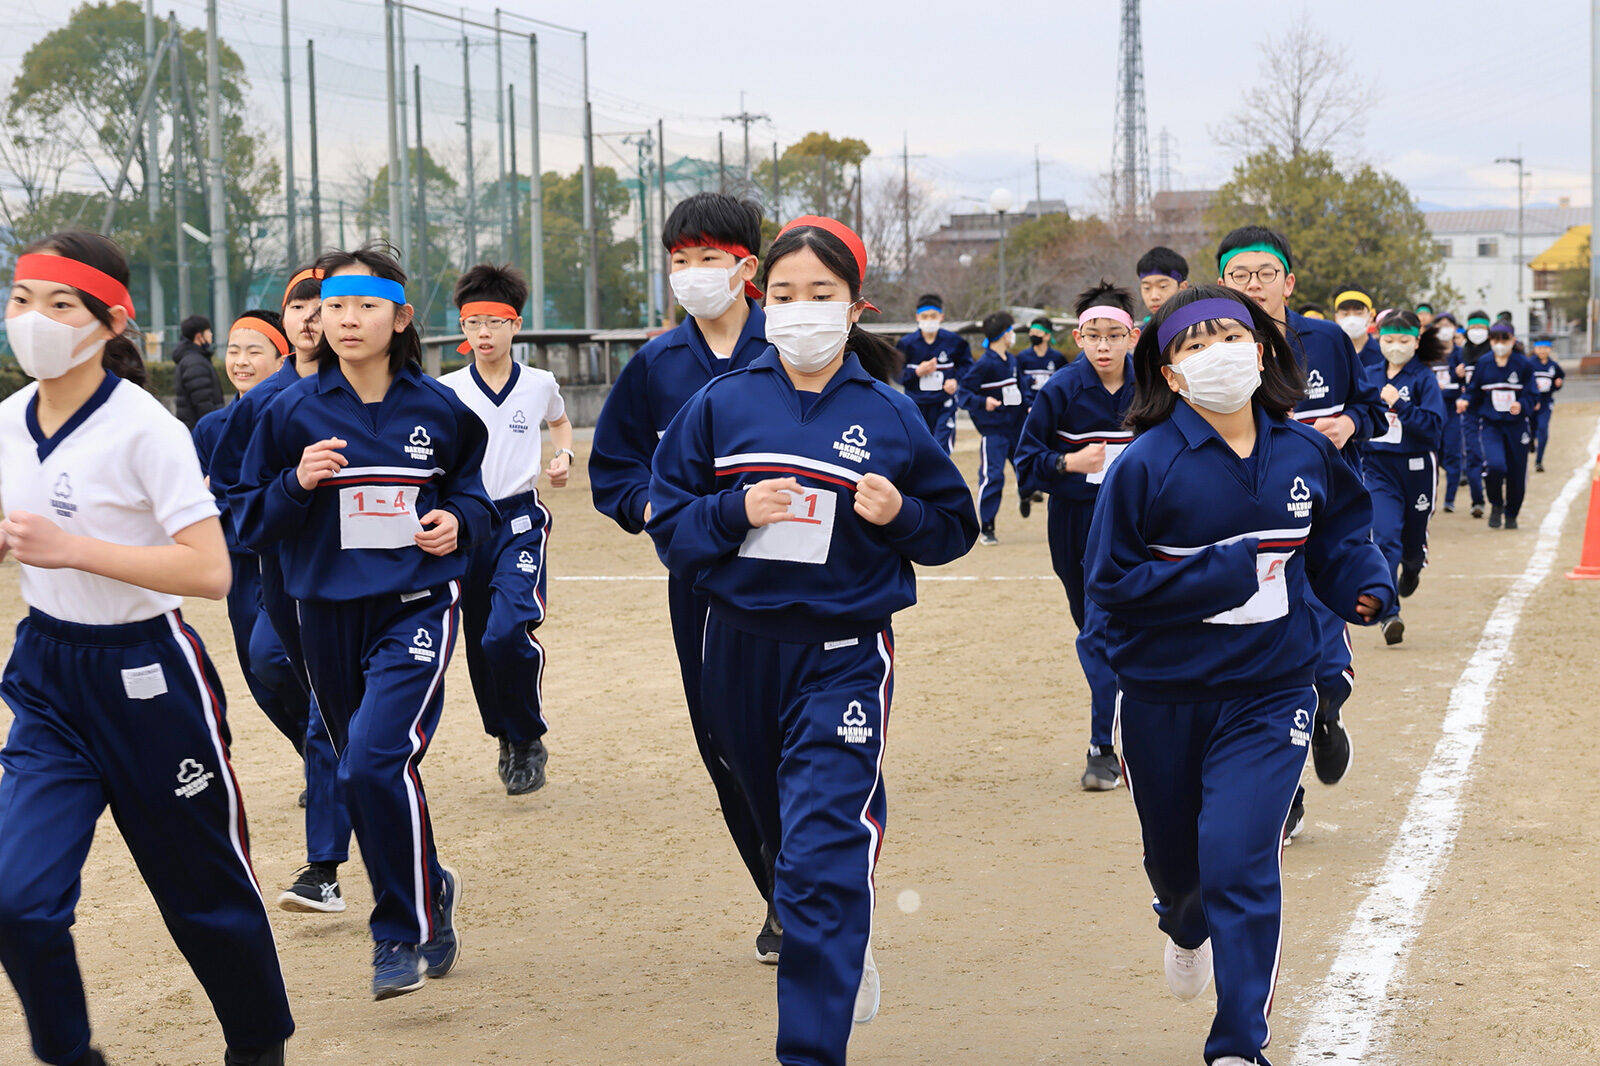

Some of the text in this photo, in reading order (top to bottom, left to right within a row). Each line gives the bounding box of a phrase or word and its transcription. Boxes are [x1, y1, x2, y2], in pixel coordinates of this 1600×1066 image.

[833, 441, 871, 460] RAKUNAN
[839, 450, 863, 464] FUZOKU
[837, 726, 873, 737] RAKUNAN
[845, 735, 867, 744] FUZOKU
